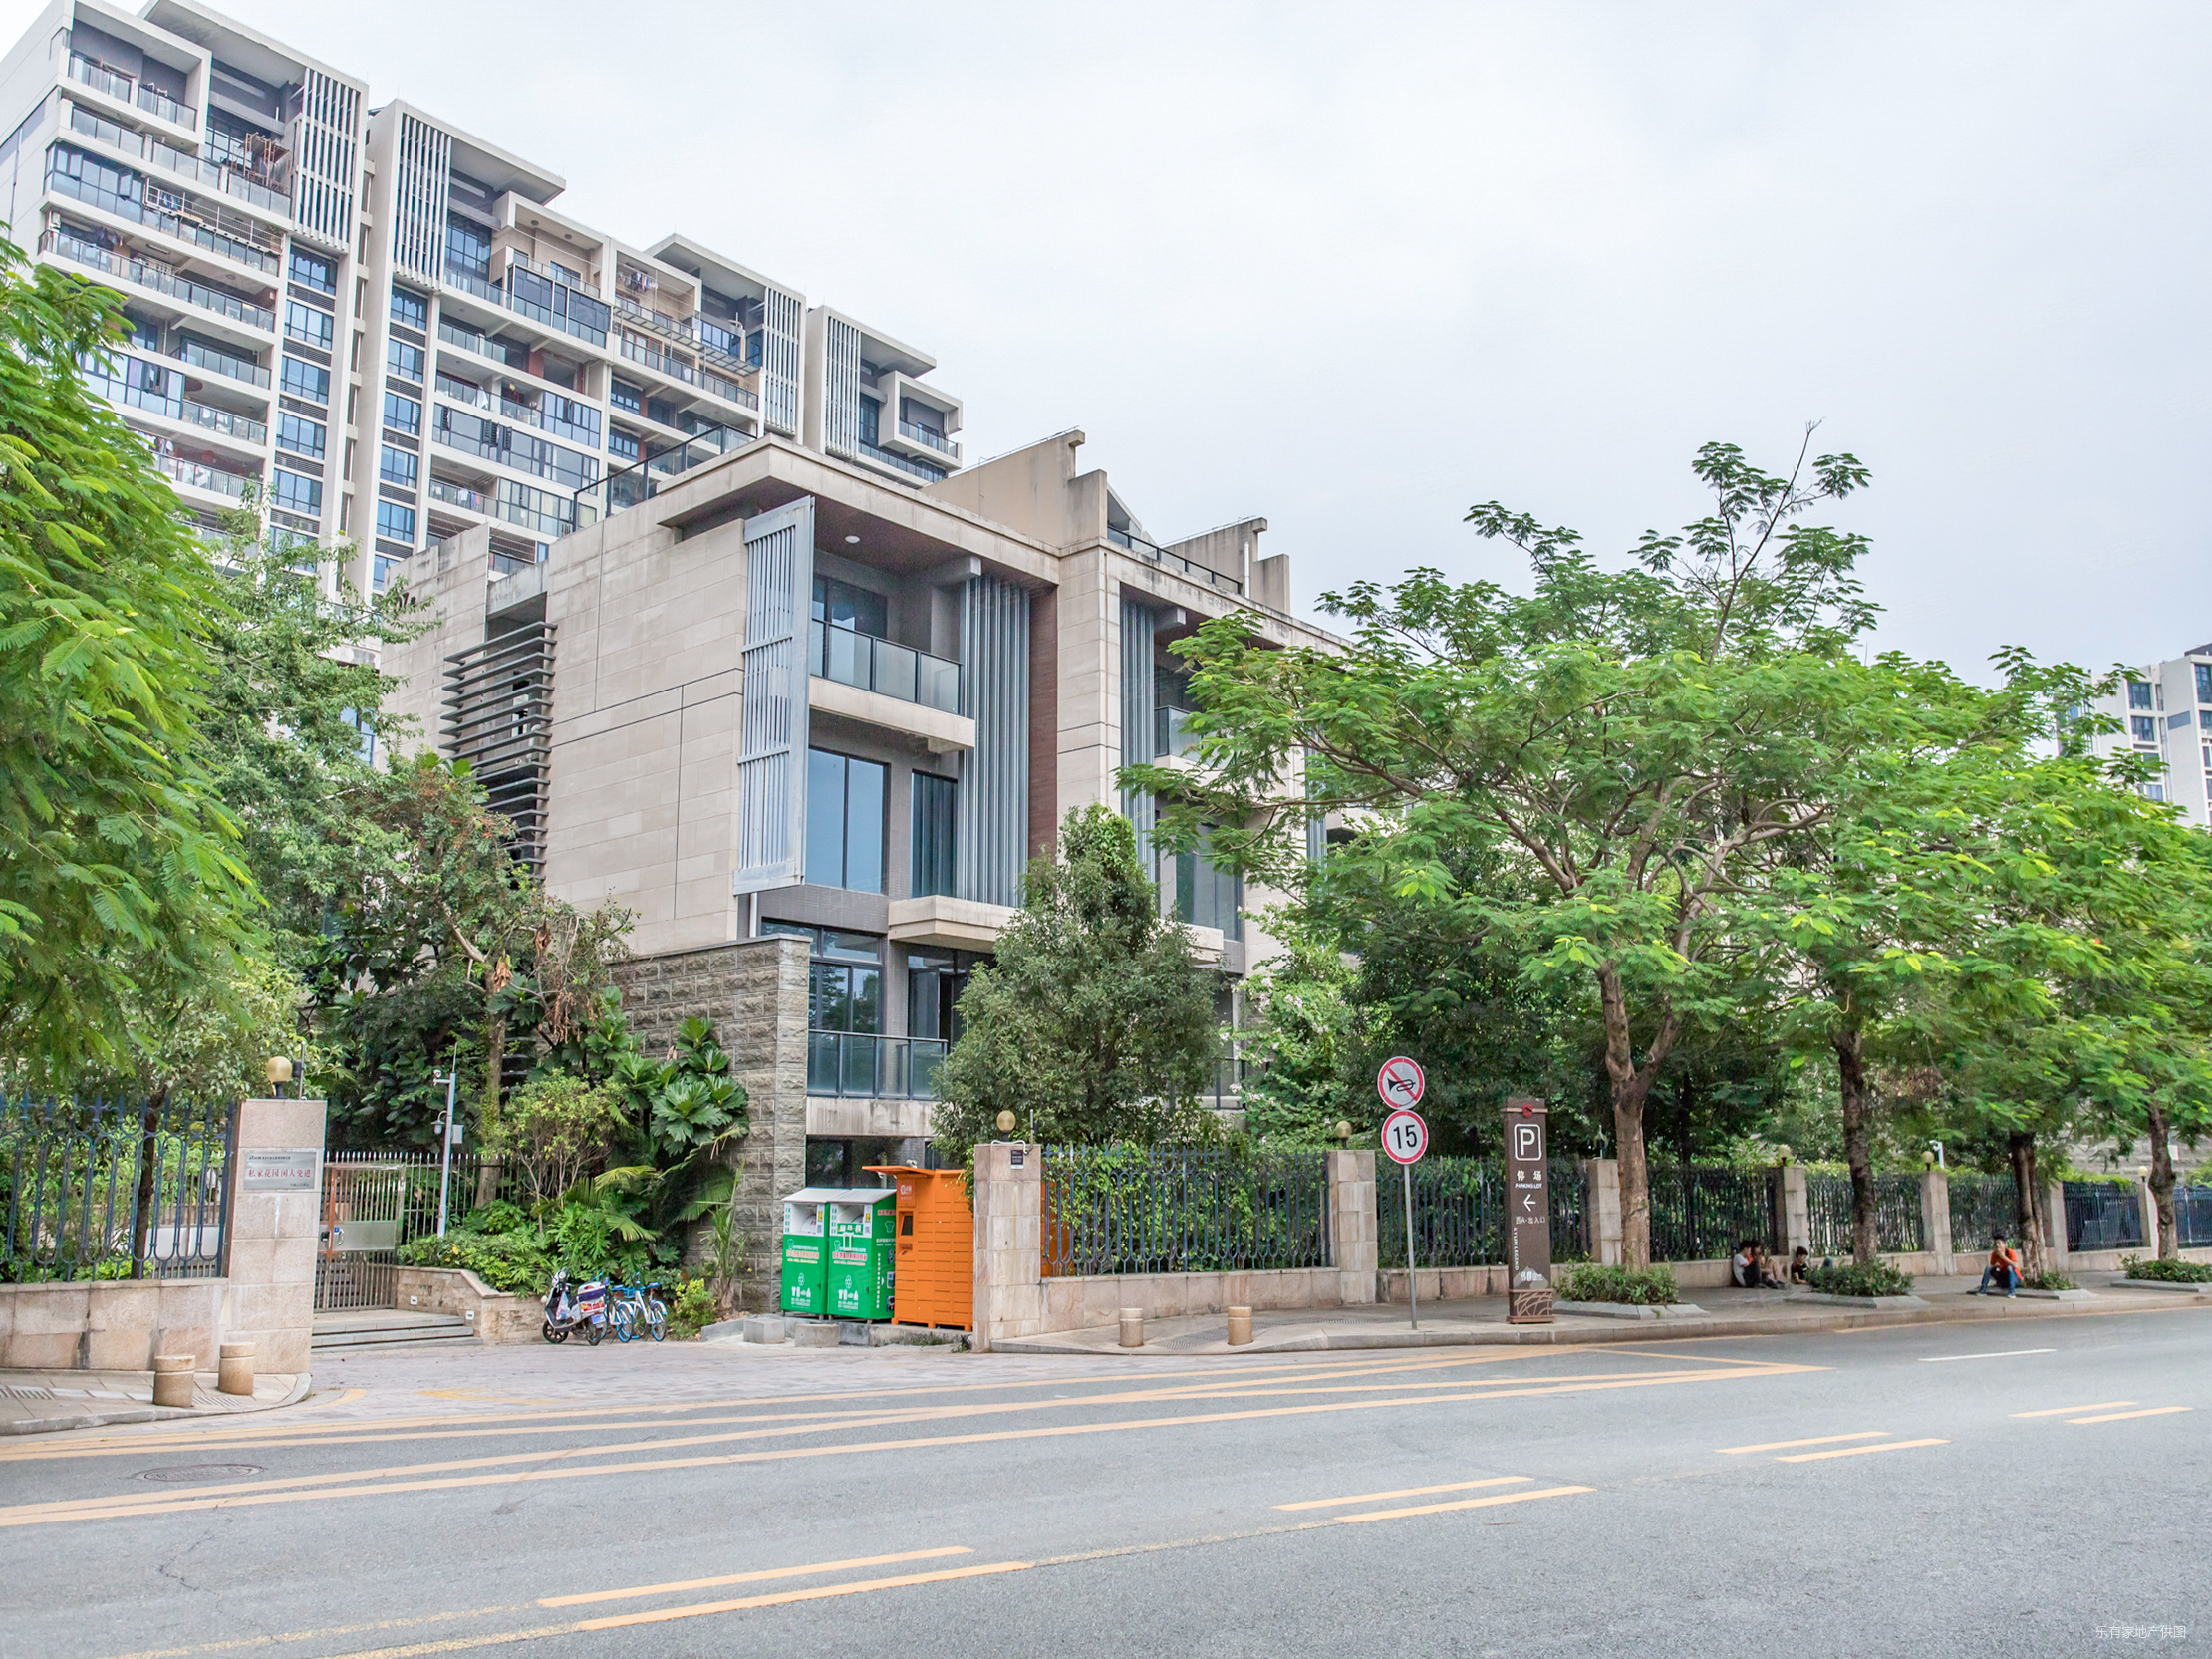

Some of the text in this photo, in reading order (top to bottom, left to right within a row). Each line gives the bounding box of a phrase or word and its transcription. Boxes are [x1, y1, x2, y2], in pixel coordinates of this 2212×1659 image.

[1393, 1125, 1417, 1149] 15
[1520, 1129, 1535, 1156] P
[249, 1169, 311, 1178] 私家花园闲人免进
